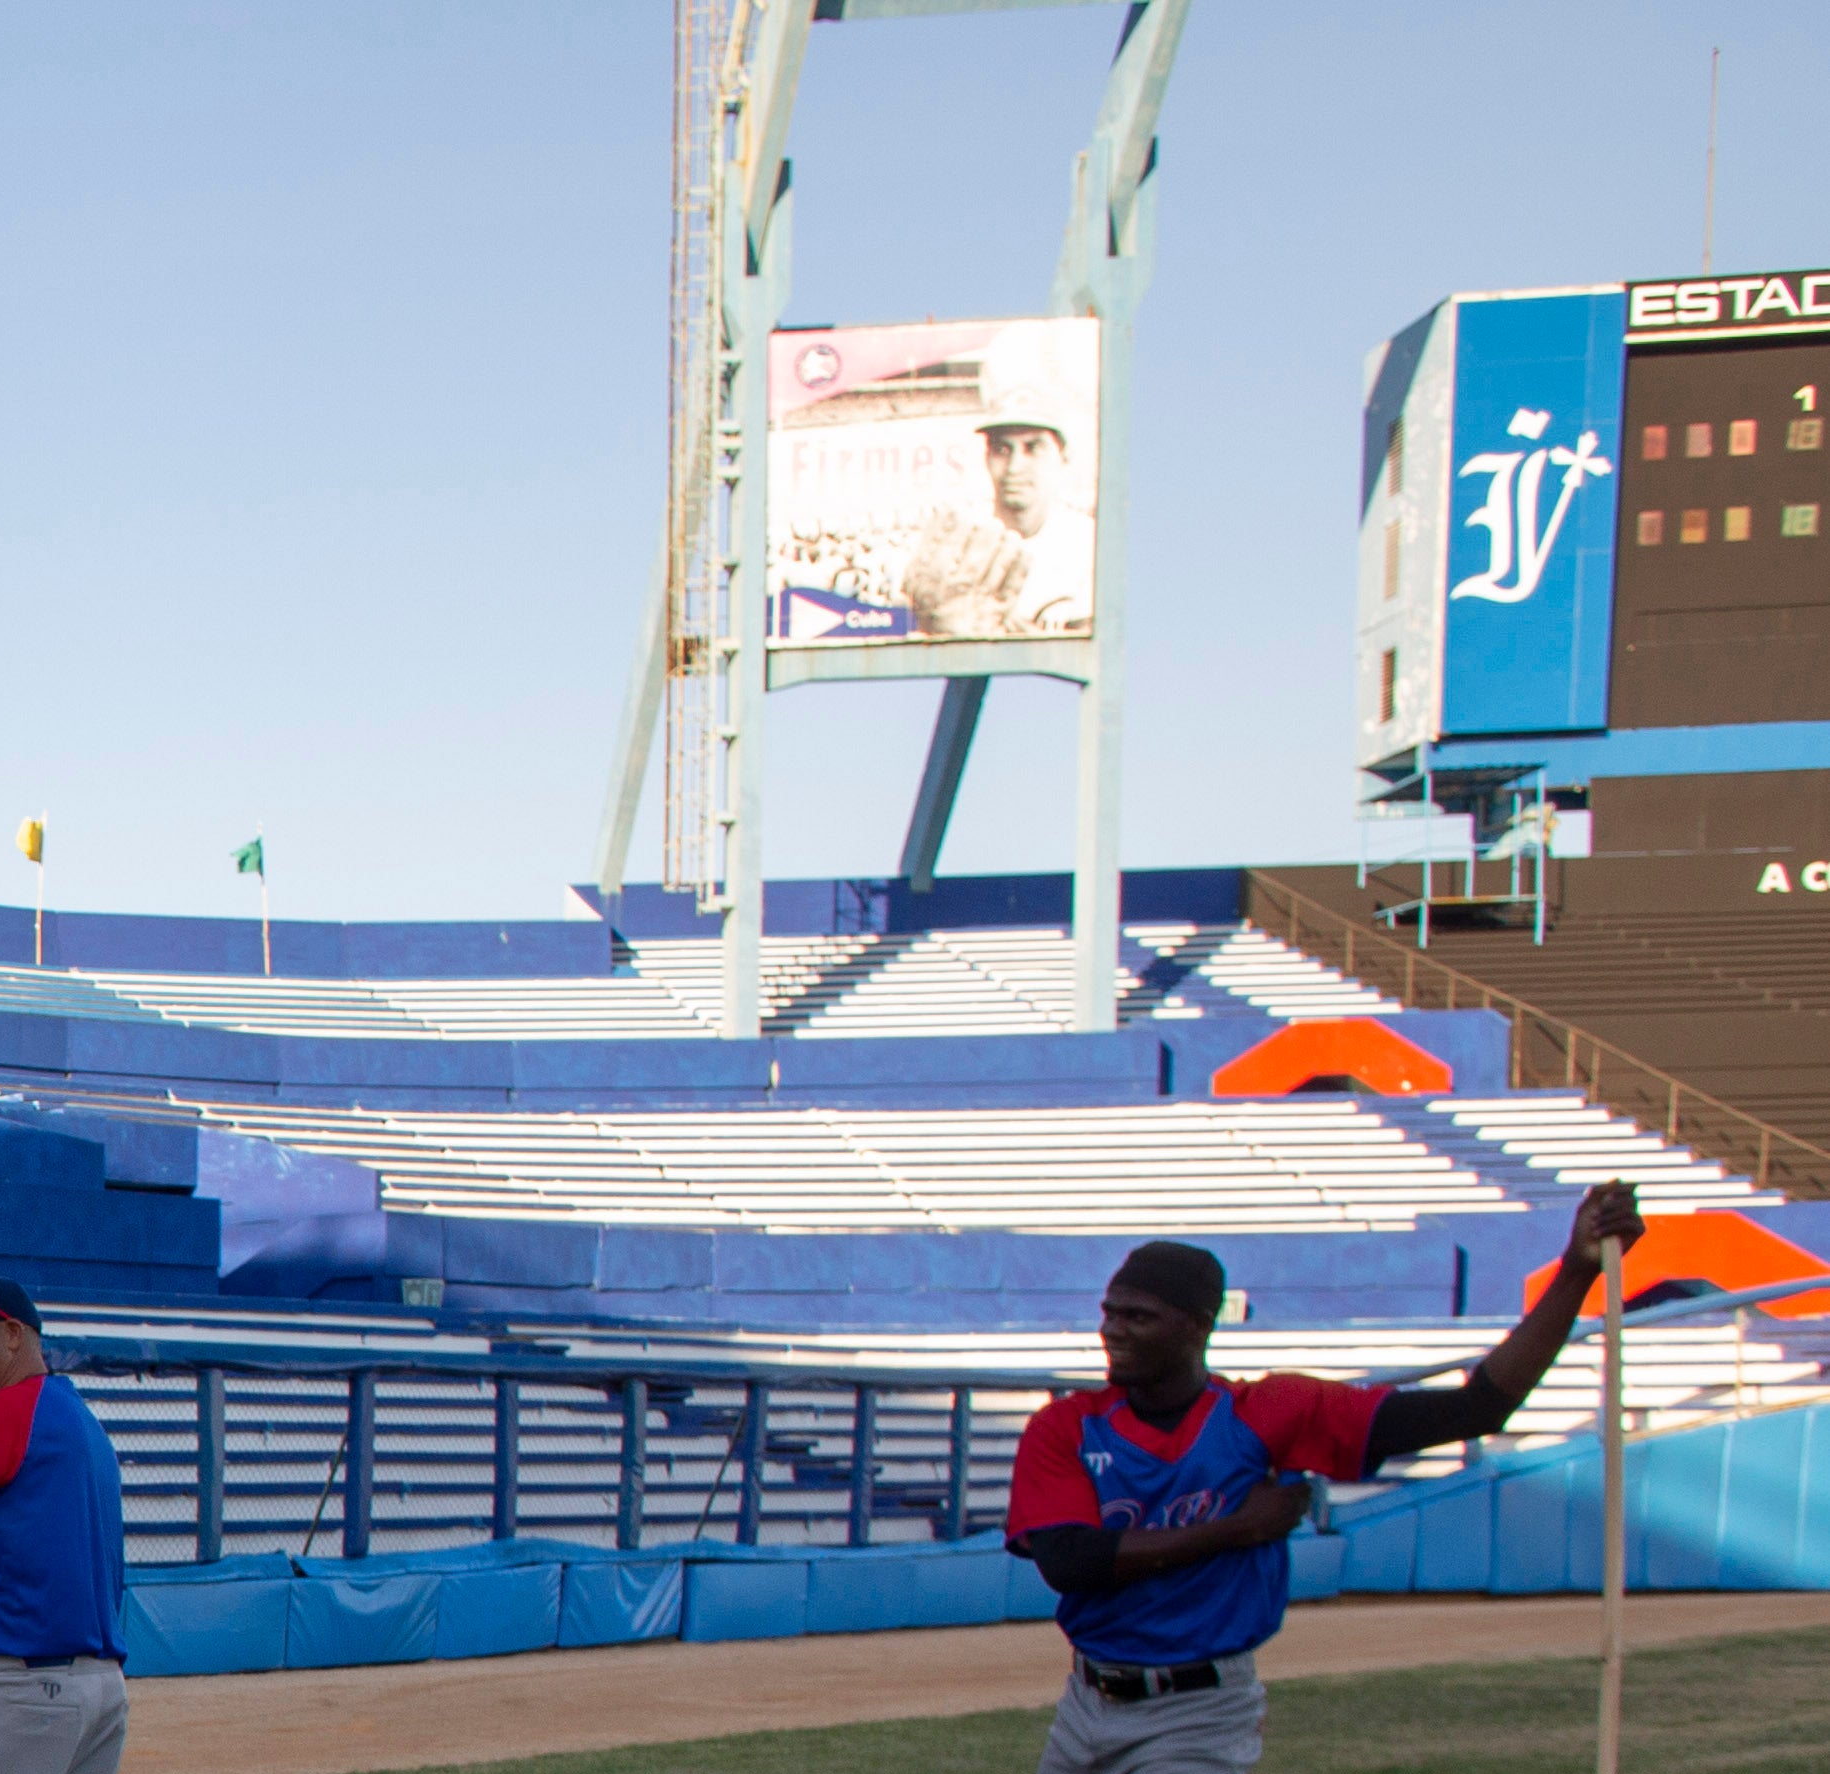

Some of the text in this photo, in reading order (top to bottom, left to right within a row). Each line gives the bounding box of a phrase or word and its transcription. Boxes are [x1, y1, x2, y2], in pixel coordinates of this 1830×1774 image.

[1793, 384, 1817, 412] 1
[790, 440, 967, 492] Firmes
[1756, 861, 1793, 894] A
